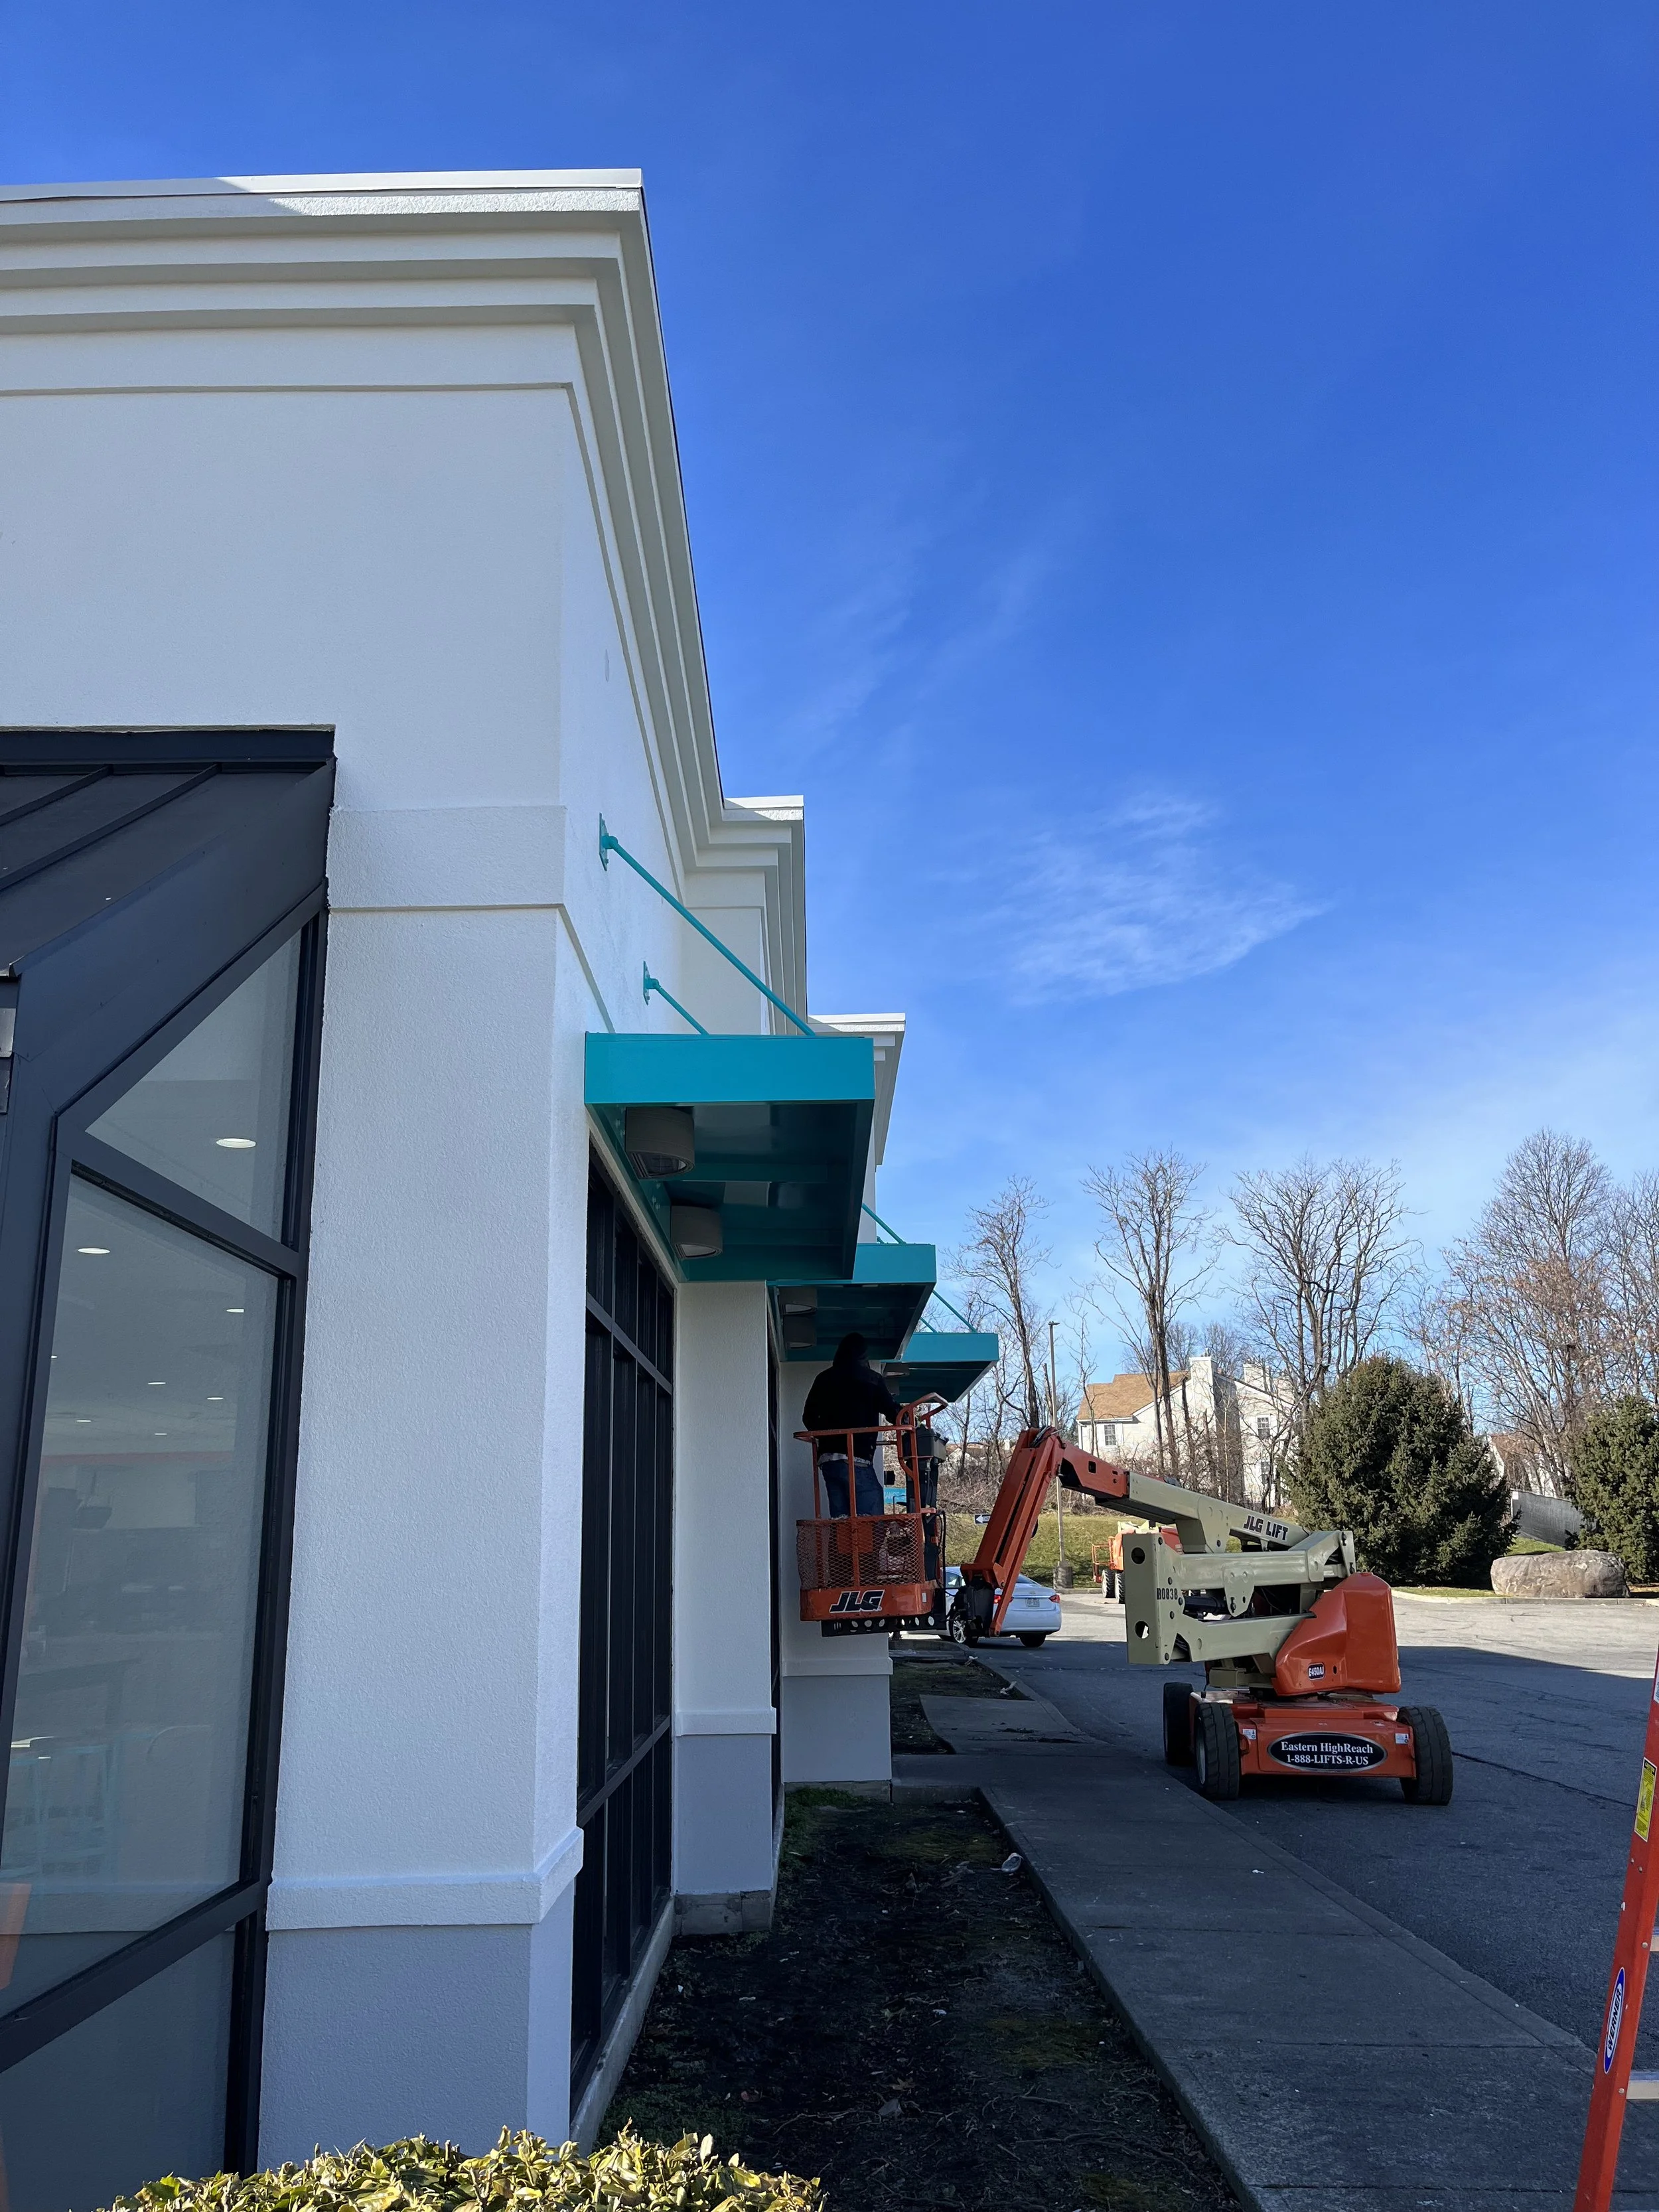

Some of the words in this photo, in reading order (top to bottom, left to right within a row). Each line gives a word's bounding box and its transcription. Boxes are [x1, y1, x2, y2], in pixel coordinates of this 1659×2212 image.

[1243, 1515, 1264, 1533] JLG
[1265, 1521, 1289, 1540] LIFT
[829, 1589, 885, 1613] JLG
[1157, 1587, 1178, 1600] B0838
[1281, 1741, 1318, 1752] Eastern
[1320, 1742, 1374, 1754] HighReach
[1287, 1754, 1369, 1765] 1-888-LIFTS-R-US
[1607, 1987, 1622, 2051] WERNER
